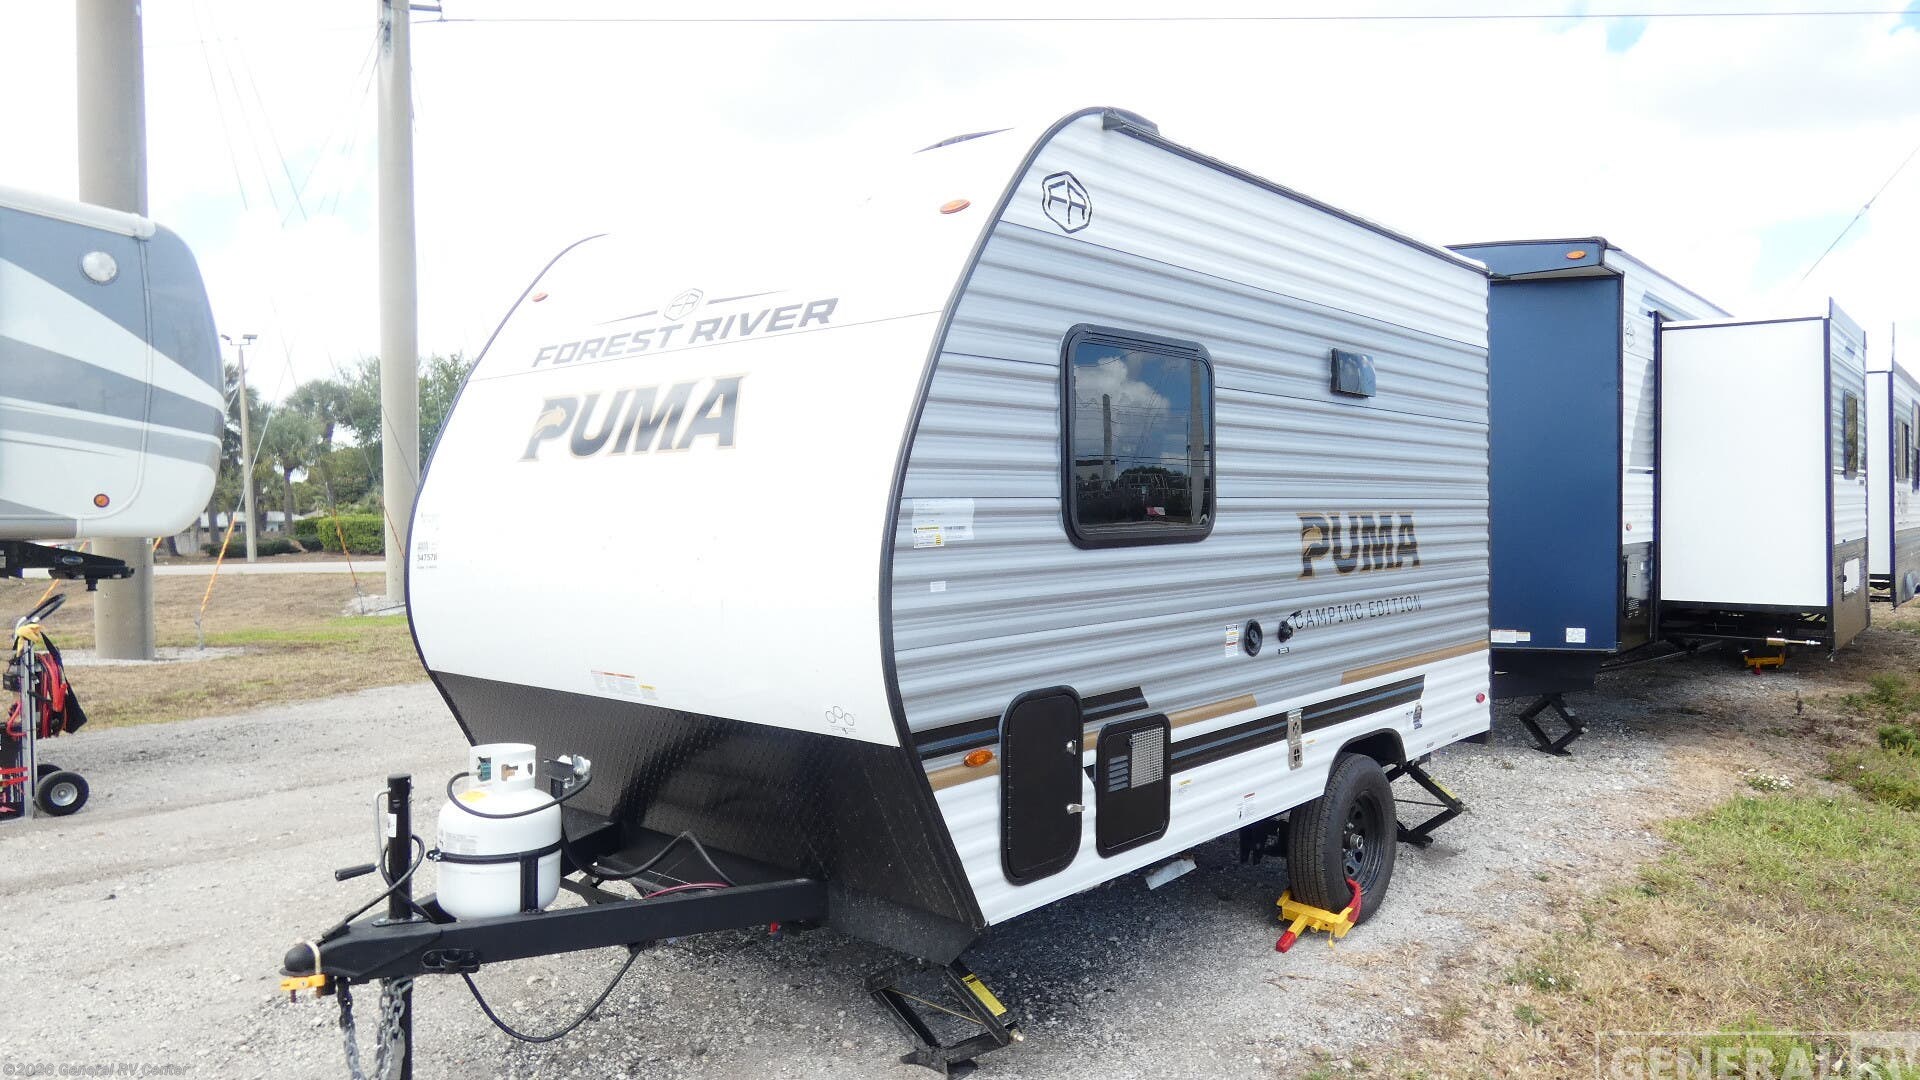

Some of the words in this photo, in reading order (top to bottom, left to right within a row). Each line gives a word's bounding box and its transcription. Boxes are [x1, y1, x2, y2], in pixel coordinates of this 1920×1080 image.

[530, 324, 684, 368] FOREST
[688, 297, 840, 344] RIVER
[519, 373, 749, 461] PUMA
[1296, 511, 1422, 579] PUMA
[1295, 603, 1364, 630] CAMPING
[1368, 594, 1423, 618] EDITION
